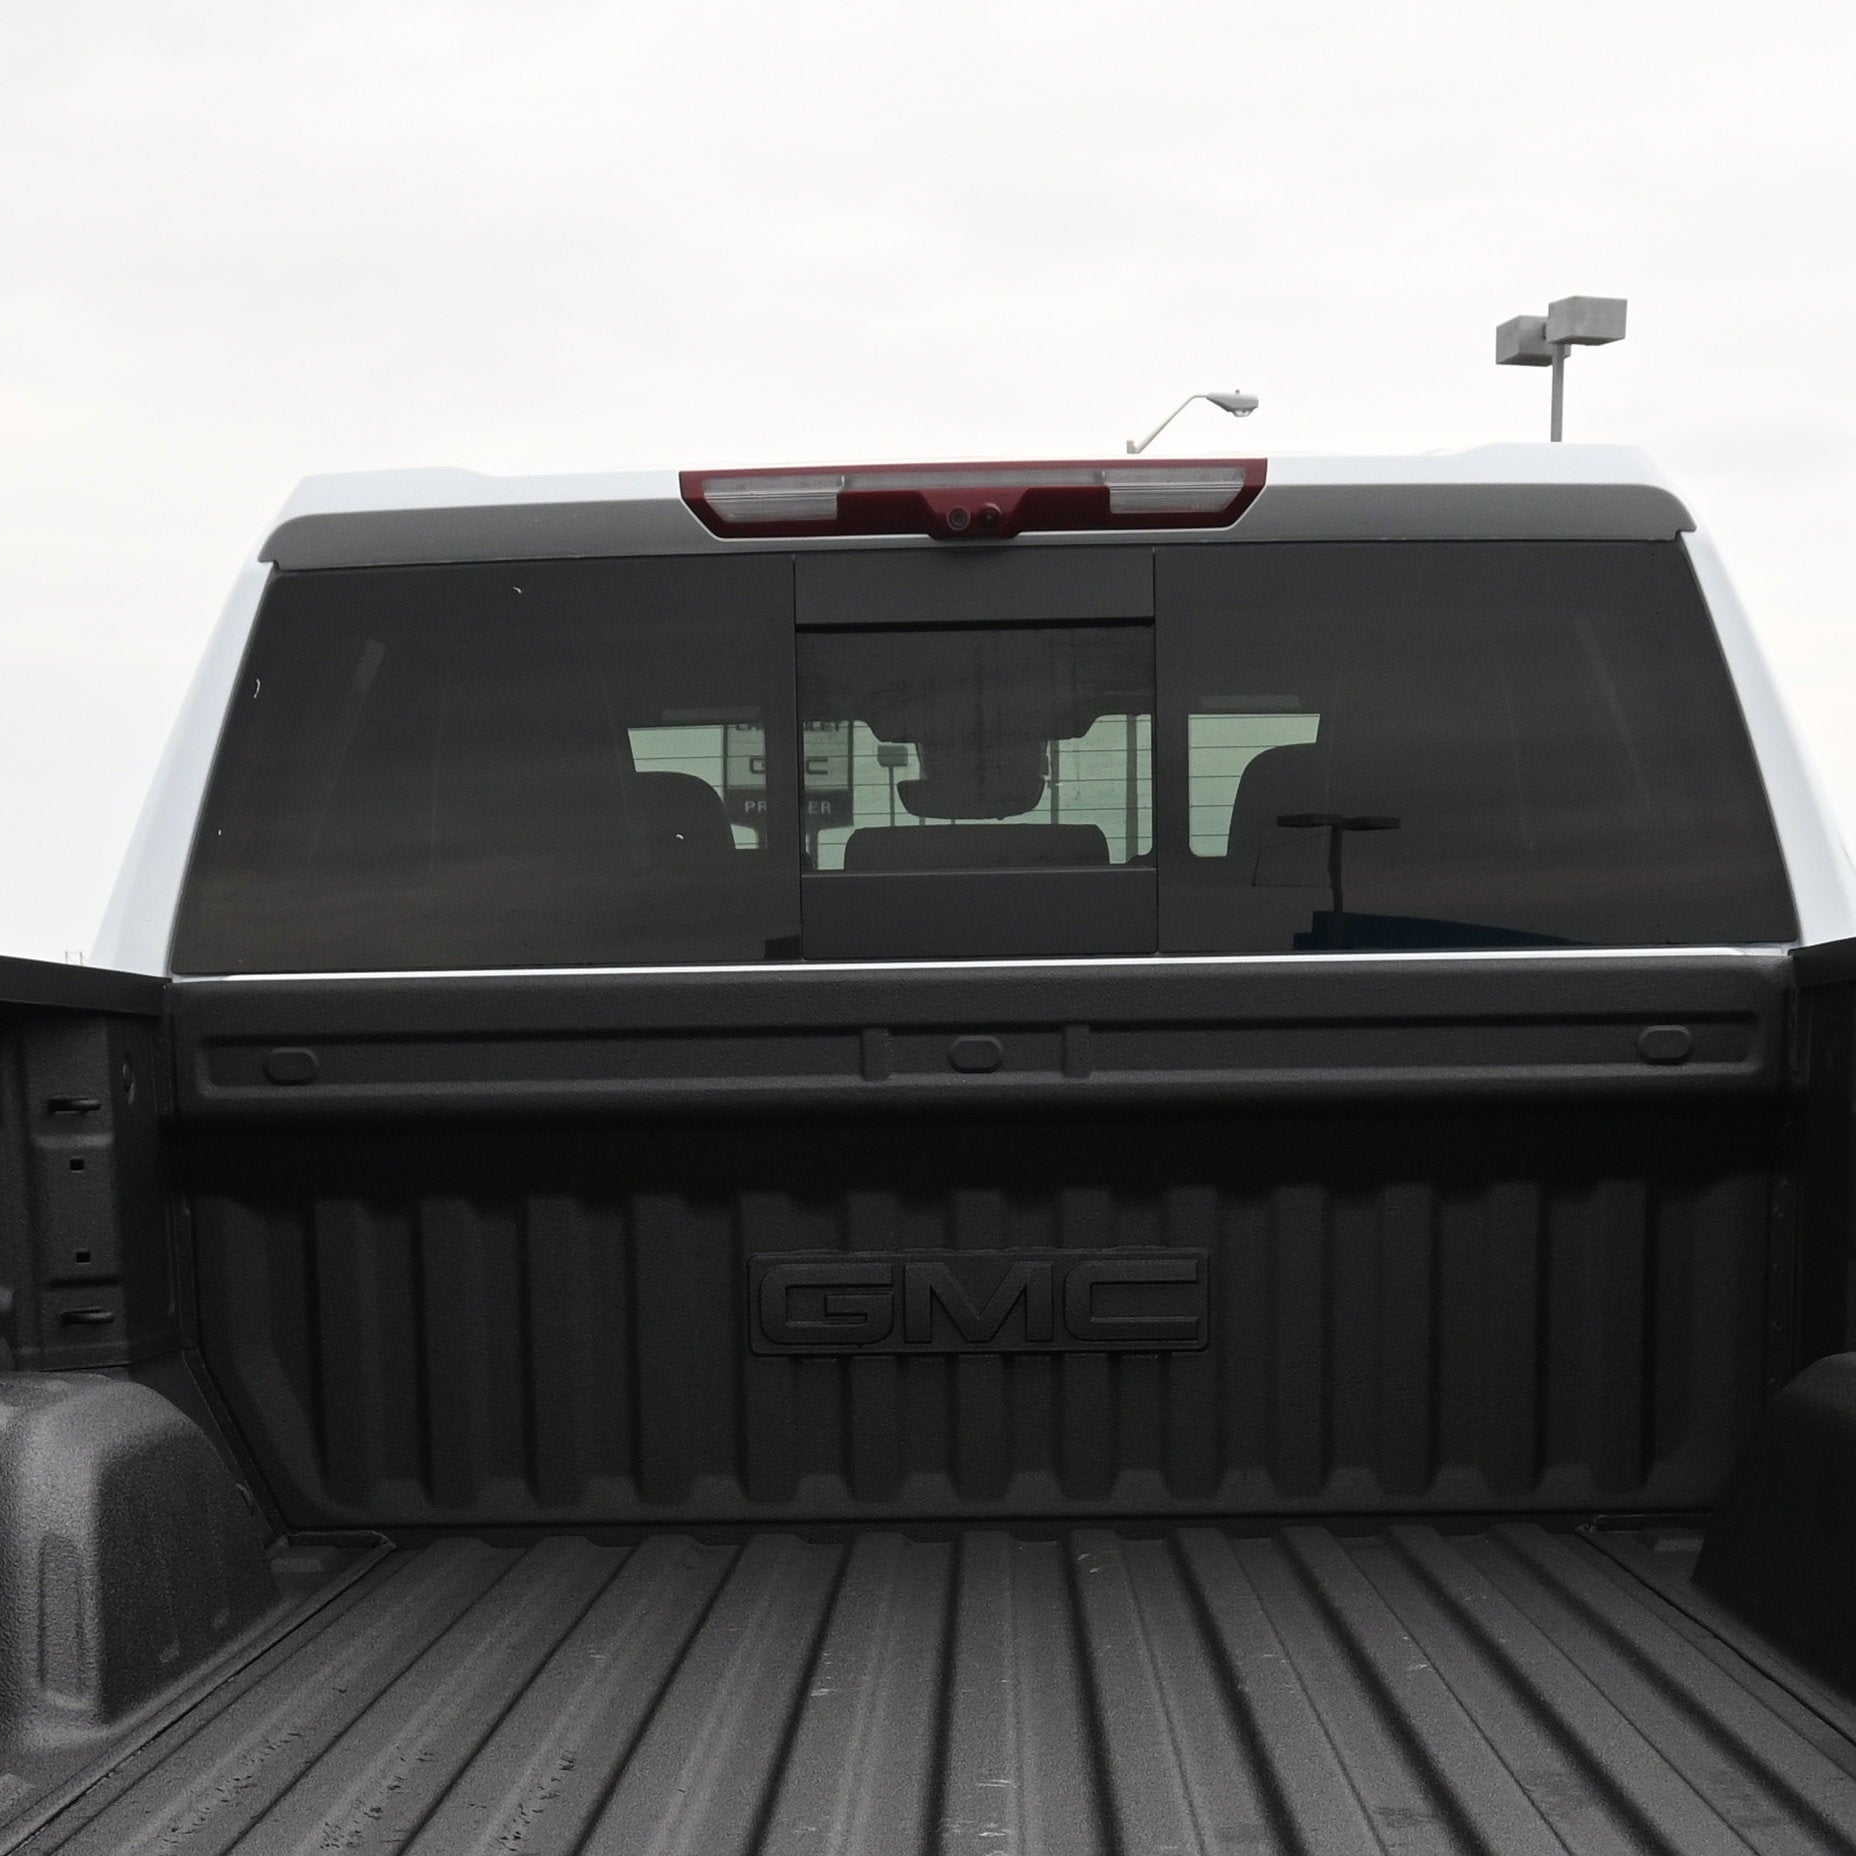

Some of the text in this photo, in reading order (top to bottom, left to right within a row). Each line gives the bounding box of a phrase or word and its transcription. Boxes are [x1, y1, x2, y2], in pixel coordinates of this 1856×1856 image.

[749, 757, 829, 775] GC
[744, 800, 832, 814] PRER
[759, 1258, 1200, 1345] GMC
